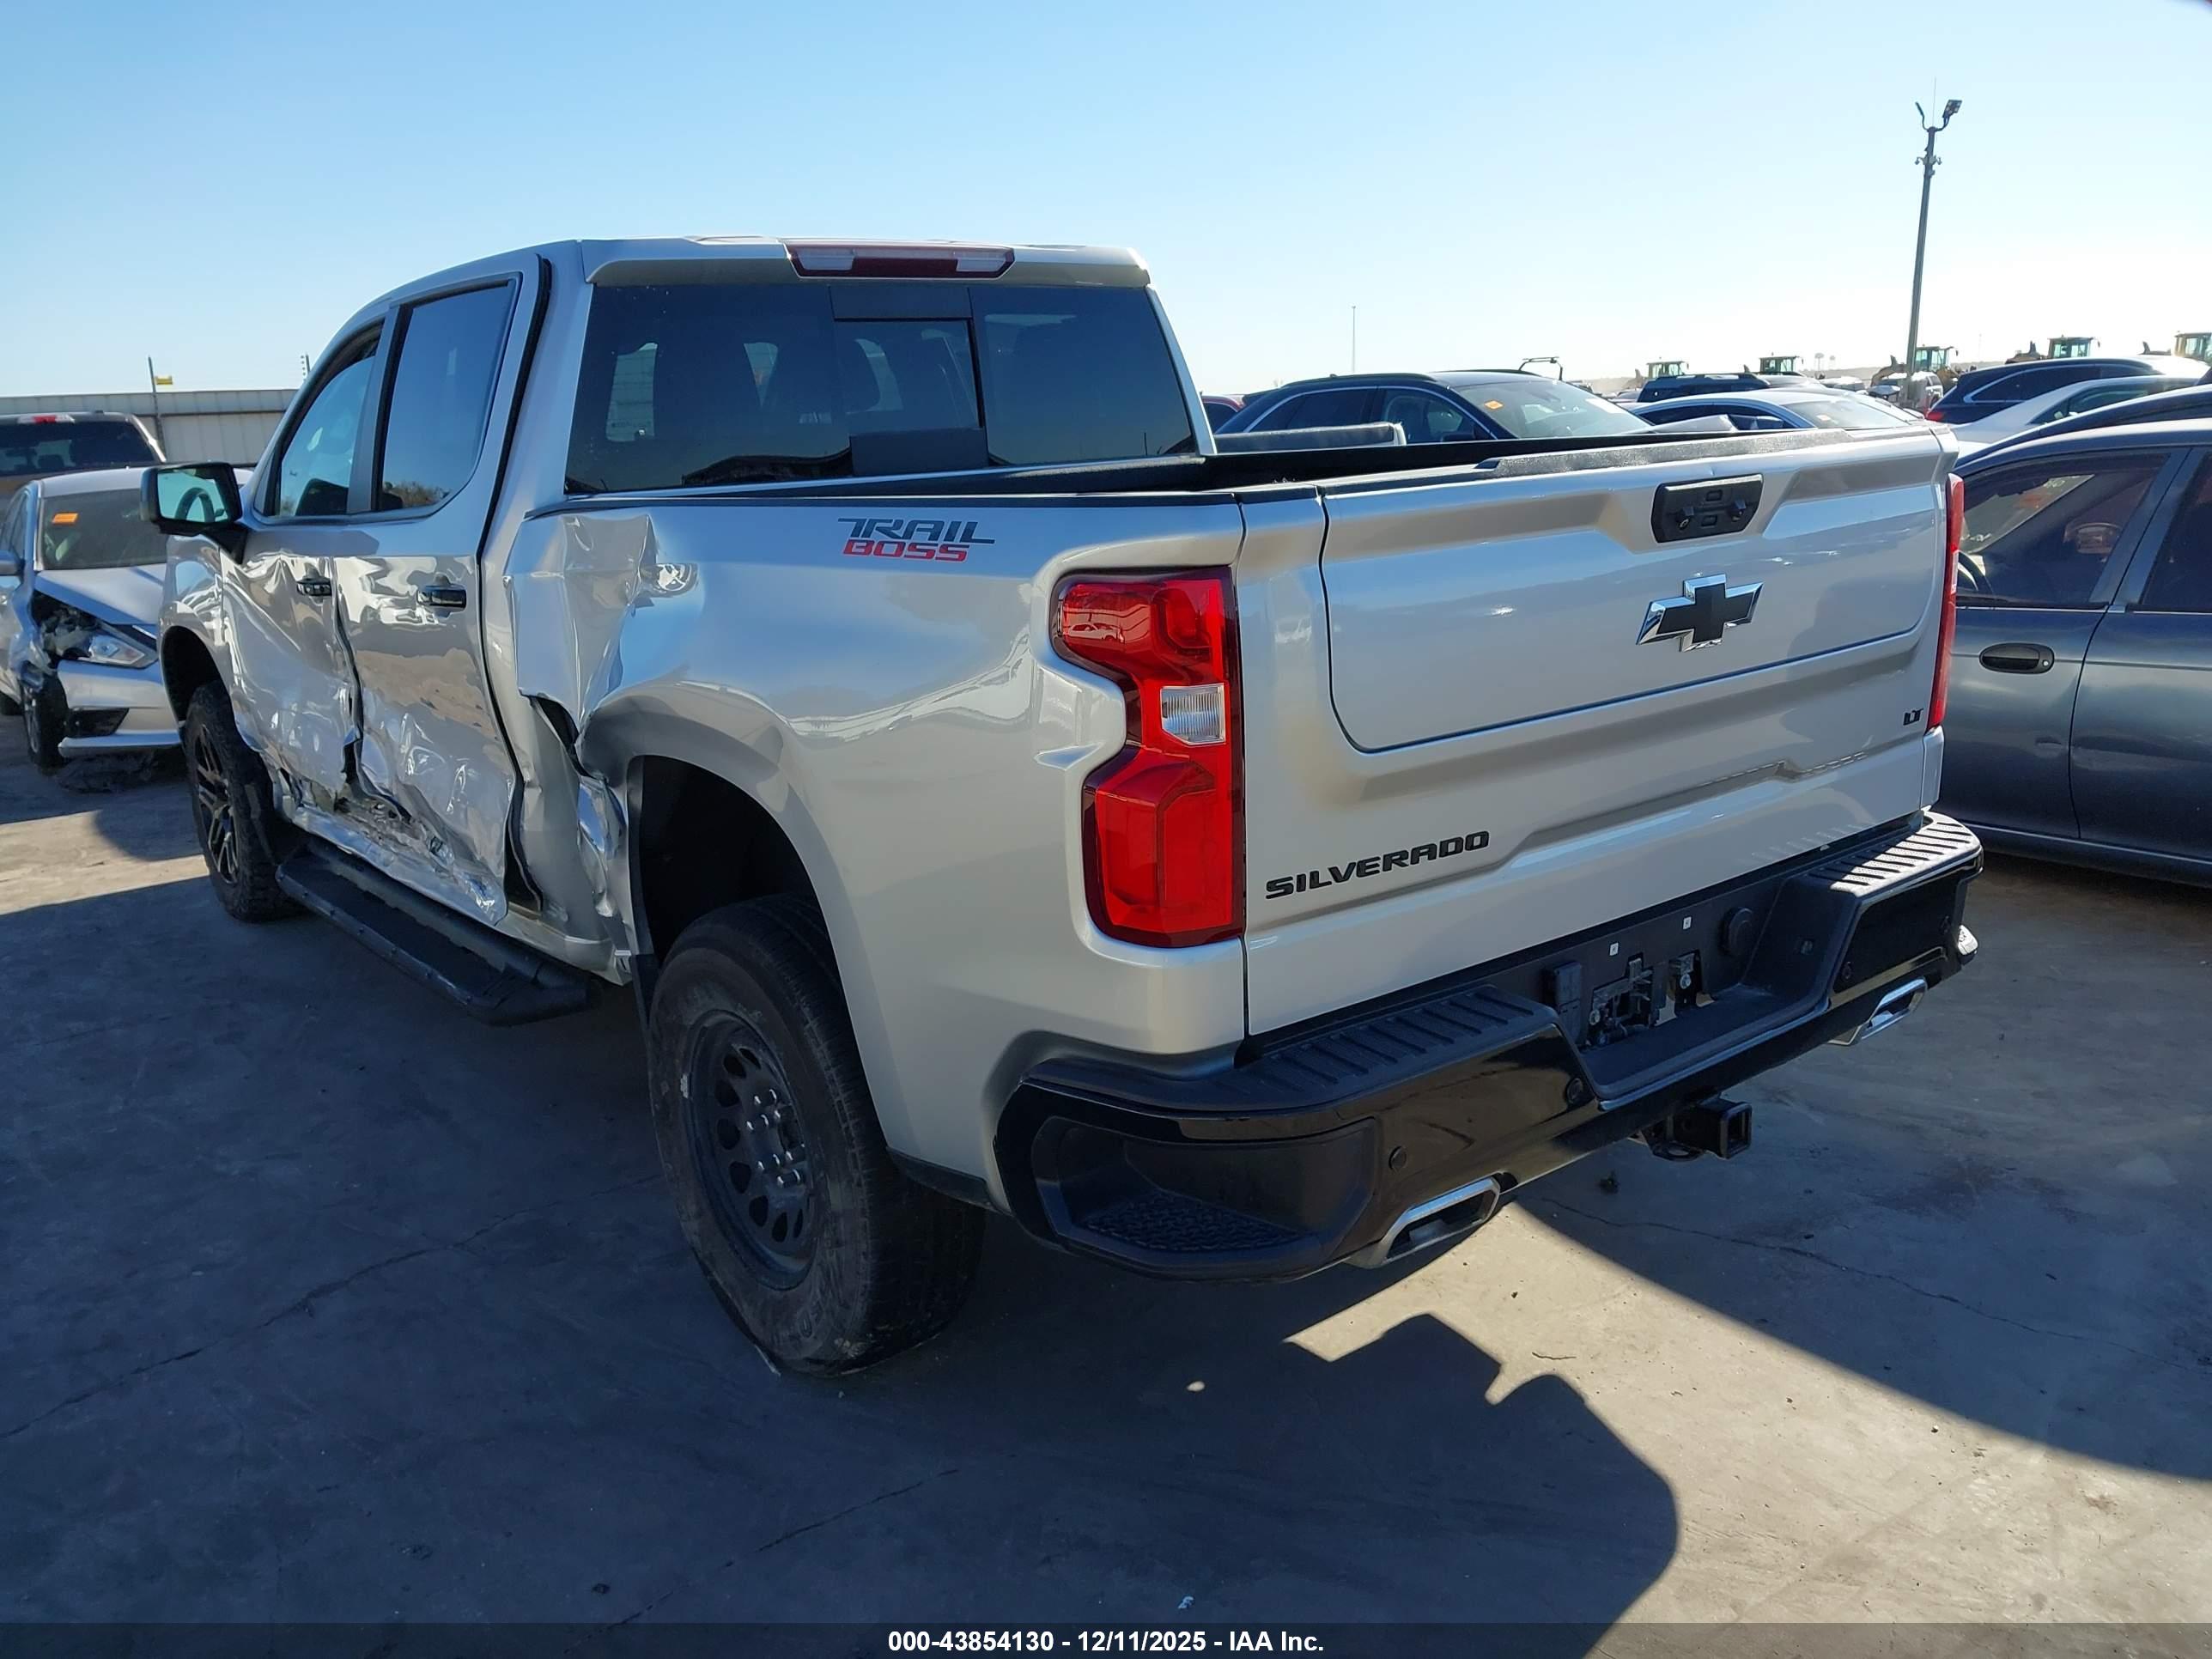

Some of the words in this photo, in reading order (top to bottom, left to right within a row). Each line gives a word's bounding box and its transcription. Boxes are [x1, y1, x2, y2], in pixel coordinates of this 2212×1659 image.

[837, 517, 995, 544] TRAIL
[842, 538, 970, 562] BOSS
[1903, 708, 1923, 726] LT
[1266, 830, 1490, 899] SILVERADO
